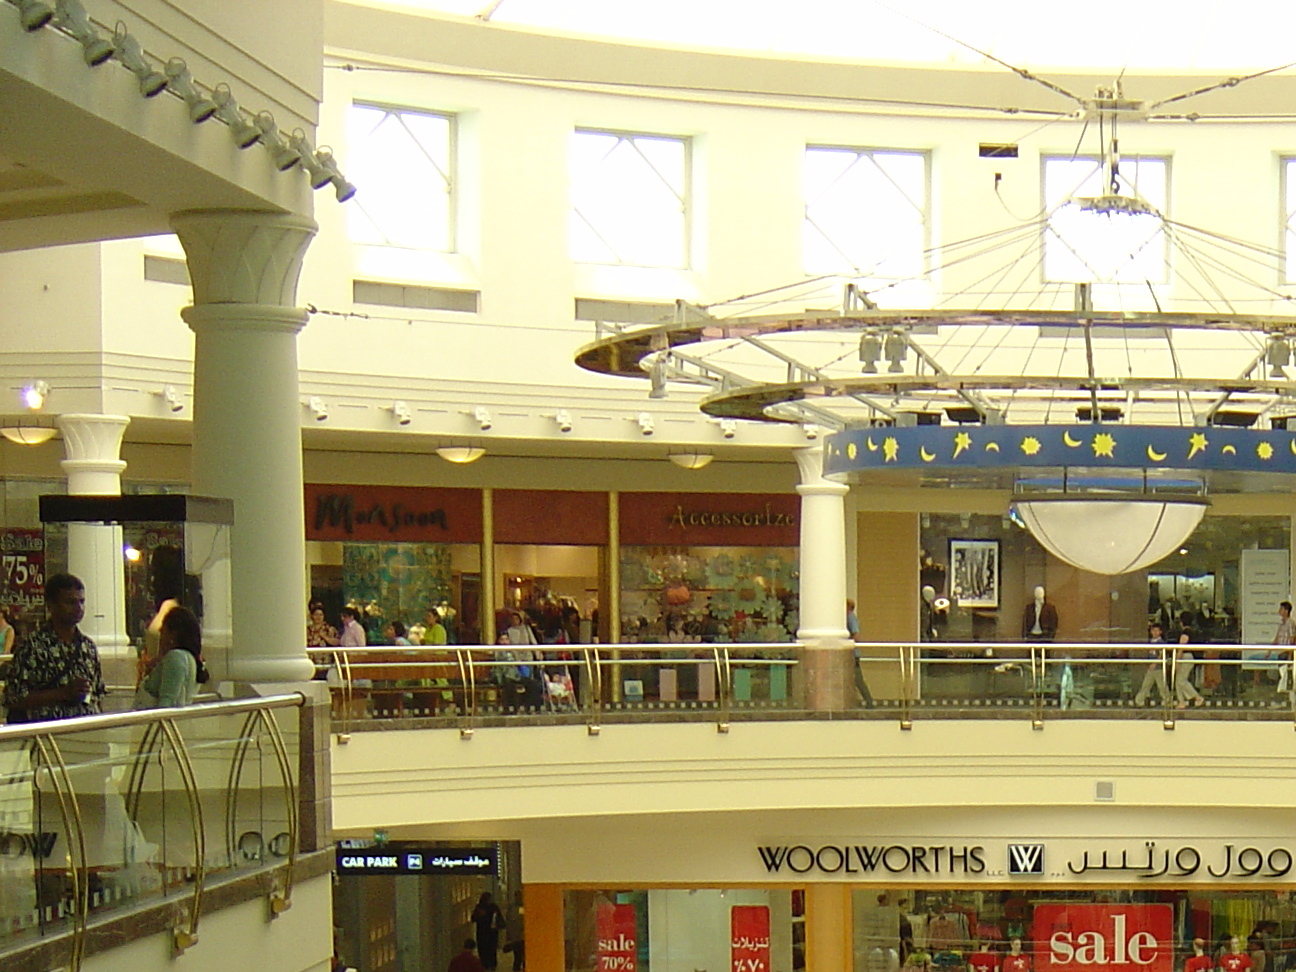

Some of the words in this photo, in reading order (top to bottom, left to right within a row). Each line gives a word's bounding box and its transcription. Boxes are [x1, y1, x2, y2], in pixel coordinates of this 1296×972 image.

[314, 493, 448, 533] Monsoon
[669, 504, 795, 527] Accessorize
[3, 556, 43, 585] 75%
[341, 857, 364, 868] CAR
[367, 856, 397, 868] PARK
[757, 844, 985, 874] WOOLWORTHS
[598, 934, 635, 951] sale
[1050, 914, 1158, 964] sale
[602, 957, 634, 970] 70%
